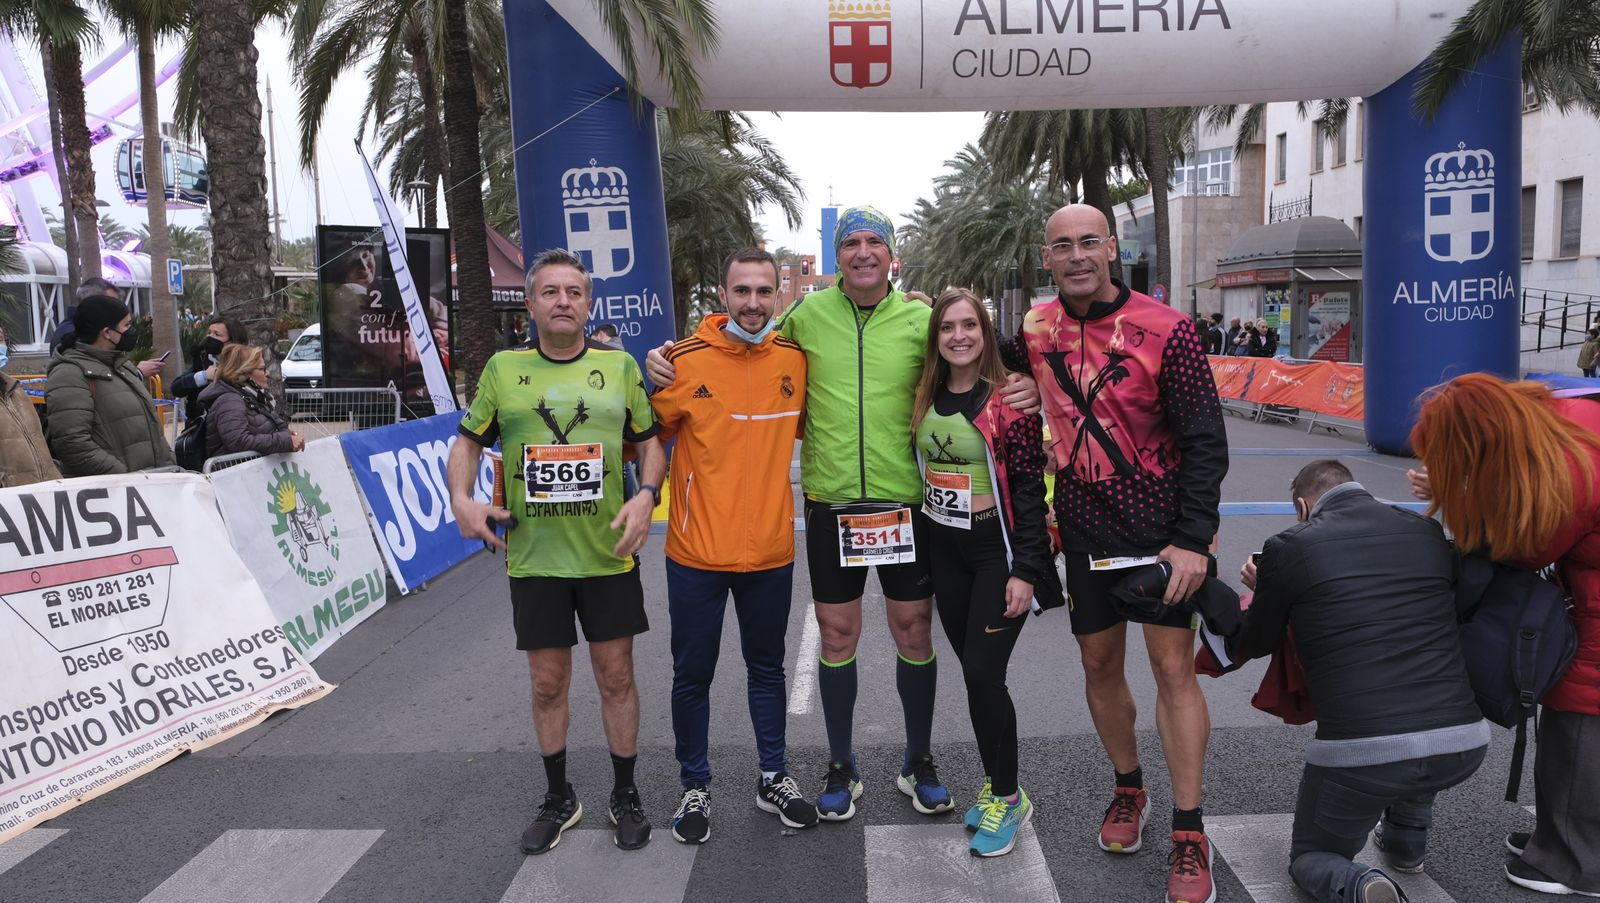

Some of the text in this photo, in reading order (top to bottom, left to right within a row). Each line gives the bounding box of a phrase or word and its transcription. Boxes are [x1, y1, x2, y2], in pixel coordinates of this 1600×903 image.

[952, 48, 1091, 78] CIUDAD
[369, 290, 383, 308] 2
[1393, 271, 1515, 304] ALMERÍA
[361, 313, 386, 323] con
[1424, 304, 1494, 322] CIUDAD
[540, 462, 591, 483] 566
[0, 486, 165, 557] AMSA
[975, 508, 999, 522] NIKE
[852, 528, 901, 546] 3511
[67, 572, 155, 603] 950 281 281
[47, 593, 151, 629] EL MORALES
[282, 568, 385, 656] ALMESU
[62, 629, 170, 677] Desde 1950
[107, 678, 127, 705] y
[131, 625, 286, 688] Contenedores
[108, 668, 255, 737] MORALES,
[20, 790, 46, 805] Cruz
[46, 783, 60, 794] de
[59, 765, 108, 788] Caravaca,
[106, 755, 123, 768] 183
[127, 742, 154, 759] 04008
[153, 721, 199, 748] ALMERÍA
[215, 711, 229, 721] 950
[228, 706, 242, 717] 281
[275, 685, 291, 697] 950
[291, 677, 307, 690] 280
